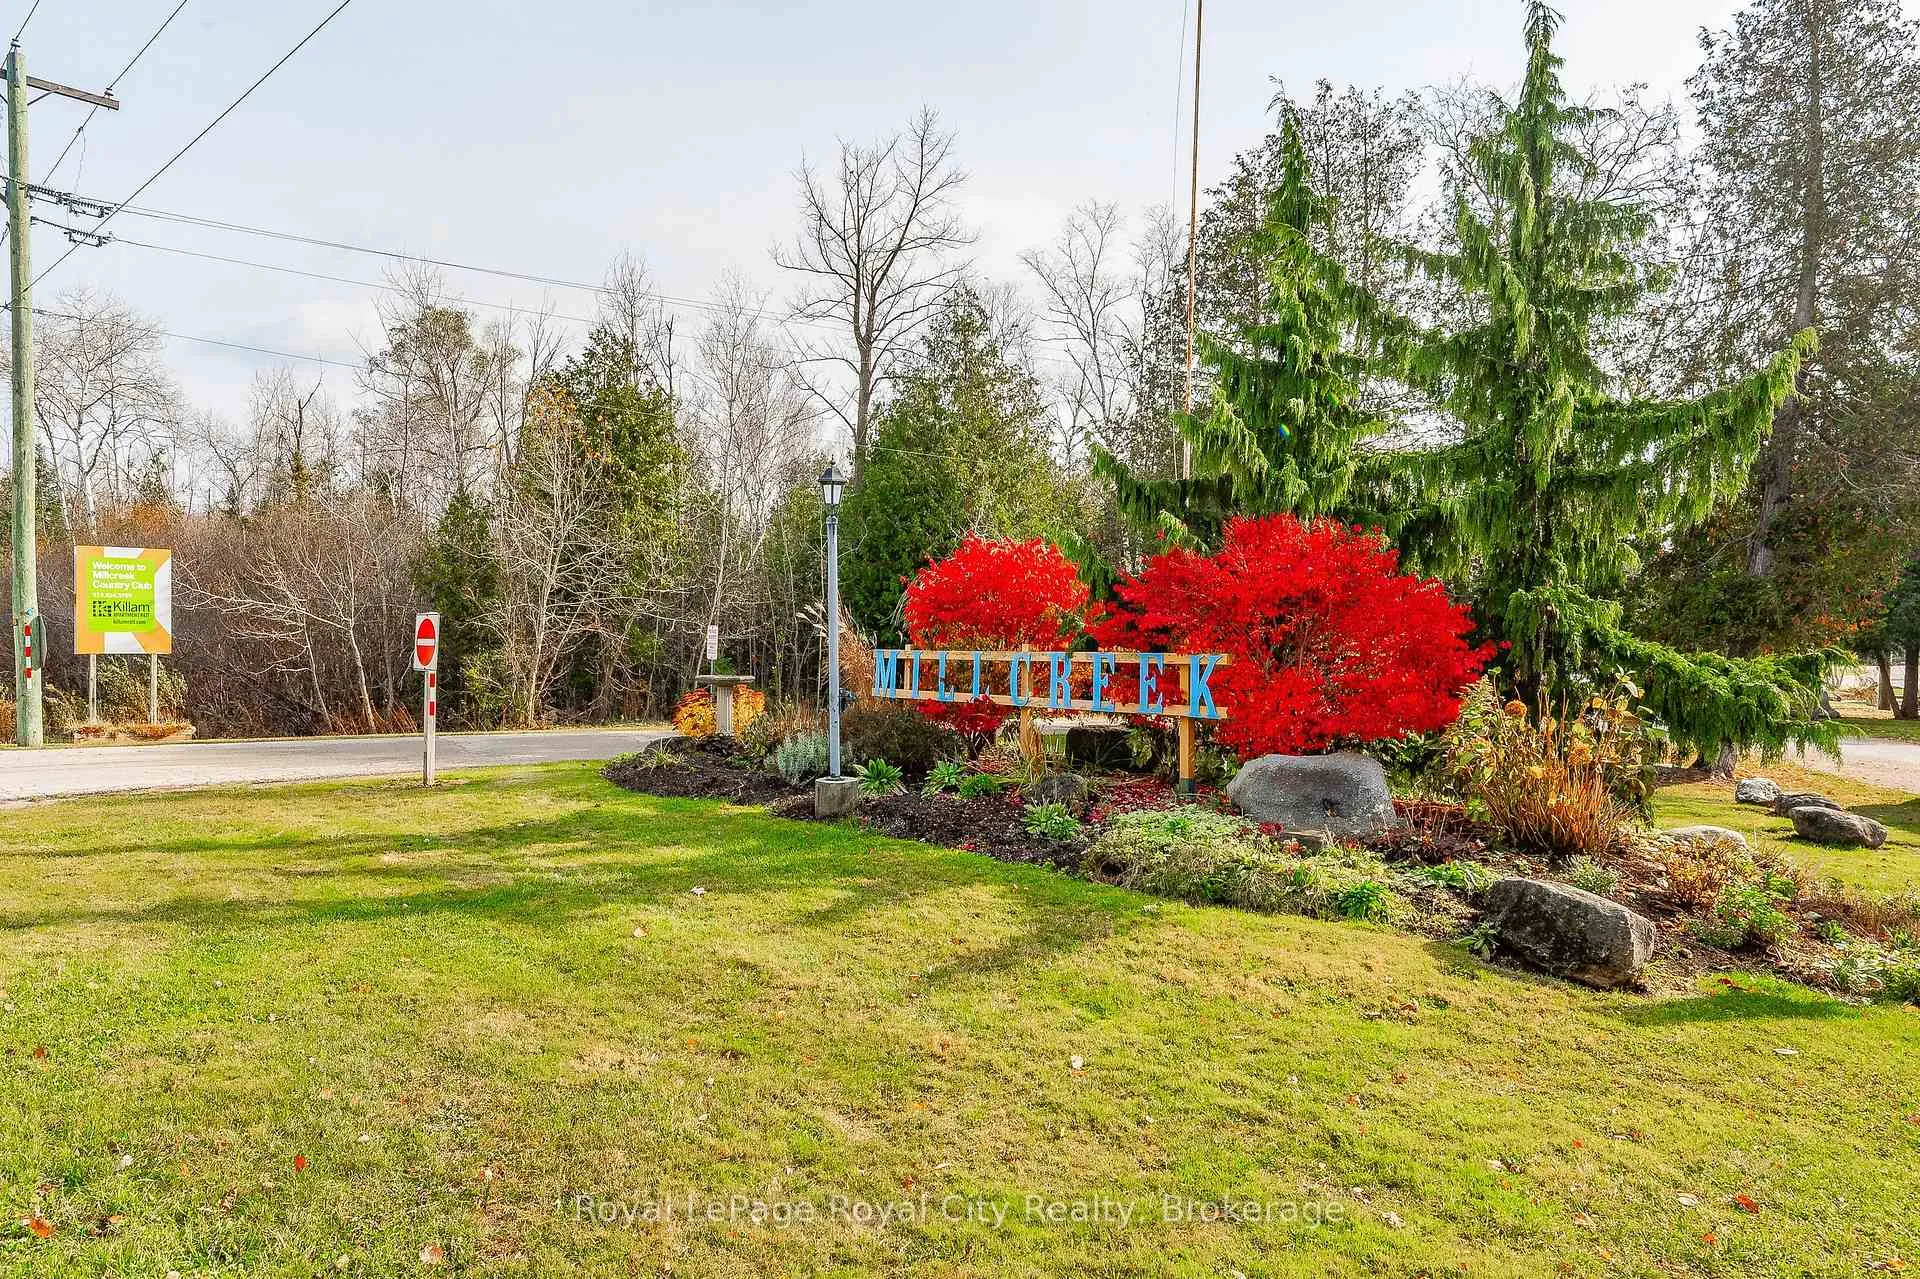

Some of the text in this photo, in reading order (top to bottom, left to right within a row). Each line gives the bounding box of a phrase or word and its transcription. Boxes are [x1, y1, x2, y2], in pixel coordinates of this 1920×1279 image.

[93, 561, 145, 571] Welcome to
[93, 571, 134, 580] Millcreek
[93, 580, 152, 590] Country Club
[113, 600, 150, 612] Killam
[874, 650, 1223, 719] MILLCREEK
